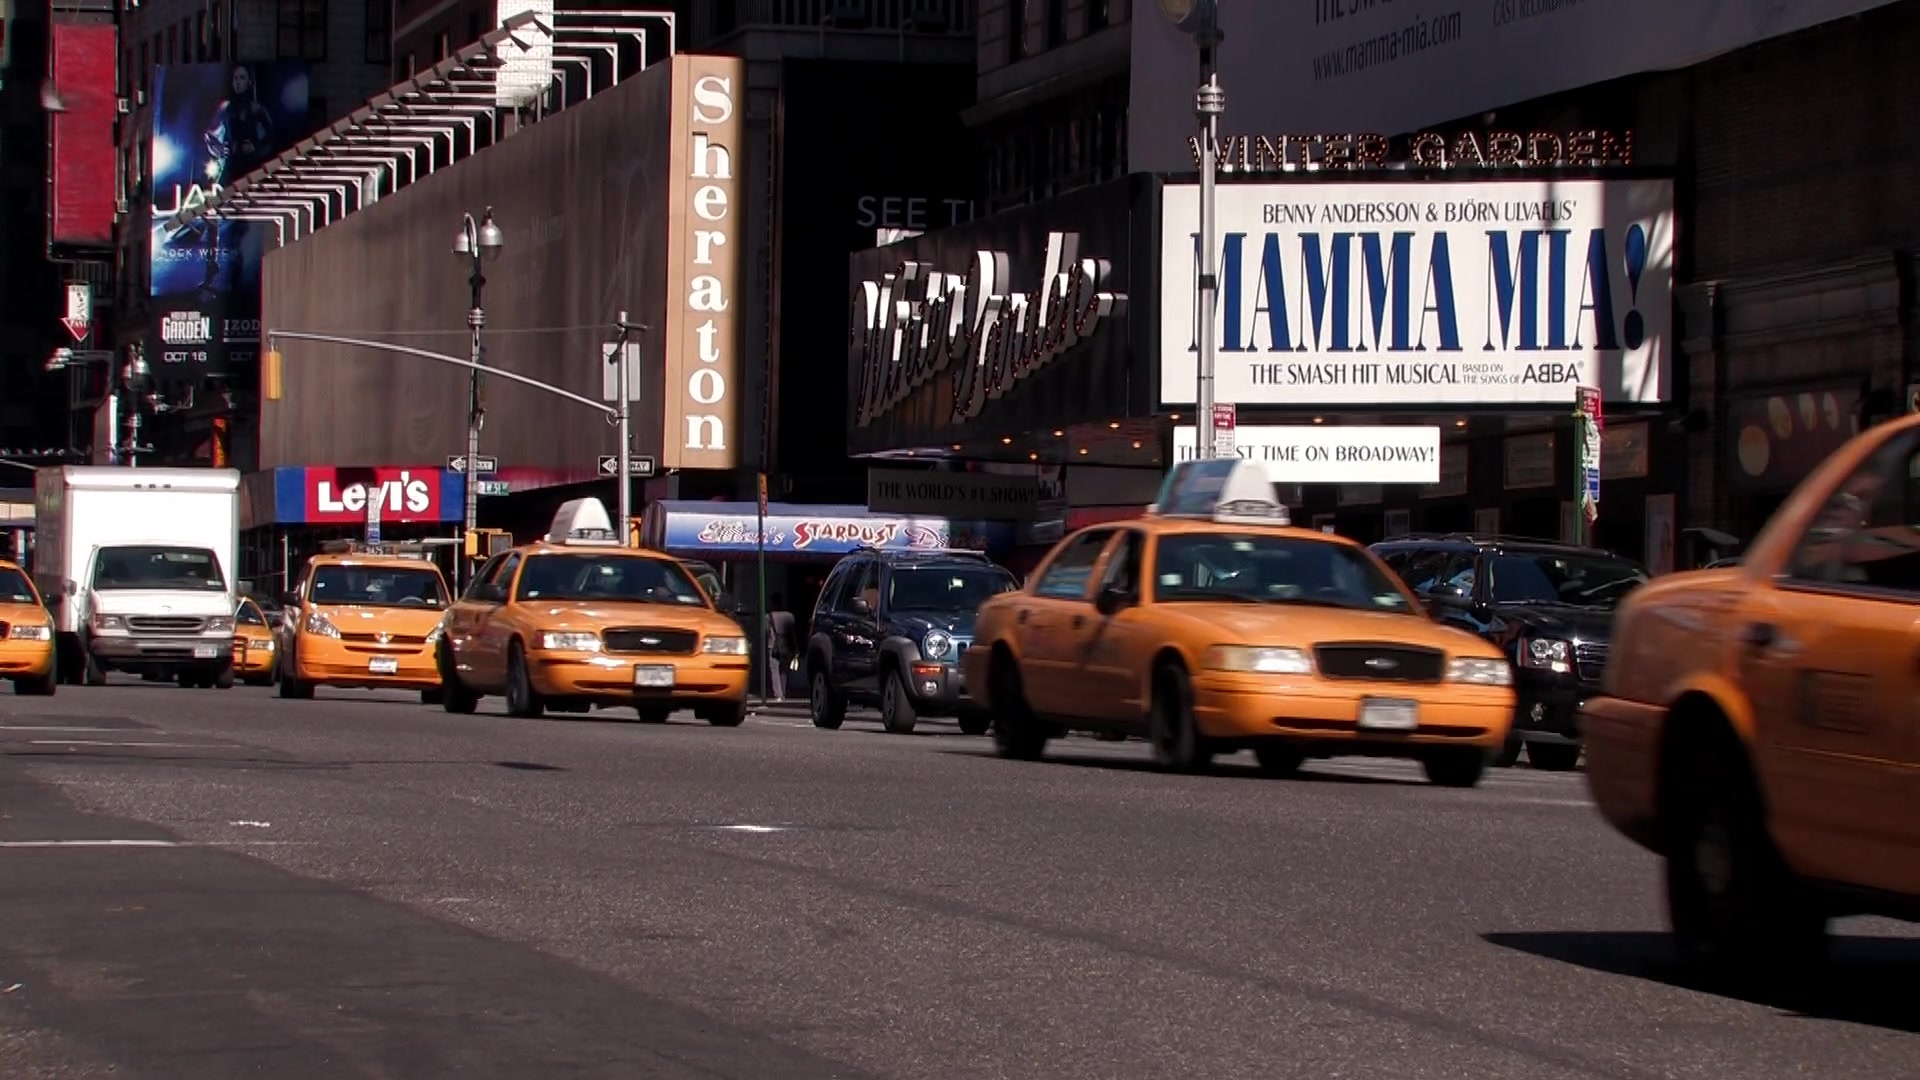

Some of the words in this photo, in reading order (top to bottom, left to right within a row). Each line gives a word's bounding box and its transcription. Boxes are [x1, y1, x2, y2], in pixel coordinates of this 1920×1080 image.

[1313, 11, 1461, 80] www.mamma-mia.com
[1188, 133, 1390, 171] WINTER
[1410, 131, 1633, 170] GARDEN
[856, 195, 928, 229] SEE
[1263, 203, 1317, 224] BENNY
[1321, 202, 1420, 223] ANDERSSON
[1426, 202, 1439, 222] &
[1445, 198, 1500, 222] BJÖRN
[1505, 200, 1577, 221] ULVAEUS'
[685, 75, 734, 450] Sheraton
[1188, 231, 1463, 352] MAMMA
[1483, 222, 1647, 351] MIA!
[224, 318, 260, 331] IZOD
[1250, 364, 1283, 385] THE
[1287, 364, 1347, 385] SMASH
[1352, 364, 1381, 384] HIT
[1385, 363, 1461, 384] MUSICAL
[1522, 363, 1580, 384] ABBA
[1262, 445, 1299, 461] TIME
[1305, 445, 1329, 461] ON
[1336, 445, 1435, 462] BROADWAY!
[877, 481, 901, 499] THE
[906, 482, 966, 500] WORLD'S
[991, 486, 1034, 503] SHOW!
[792, 521, 898, 549] STARDUST
